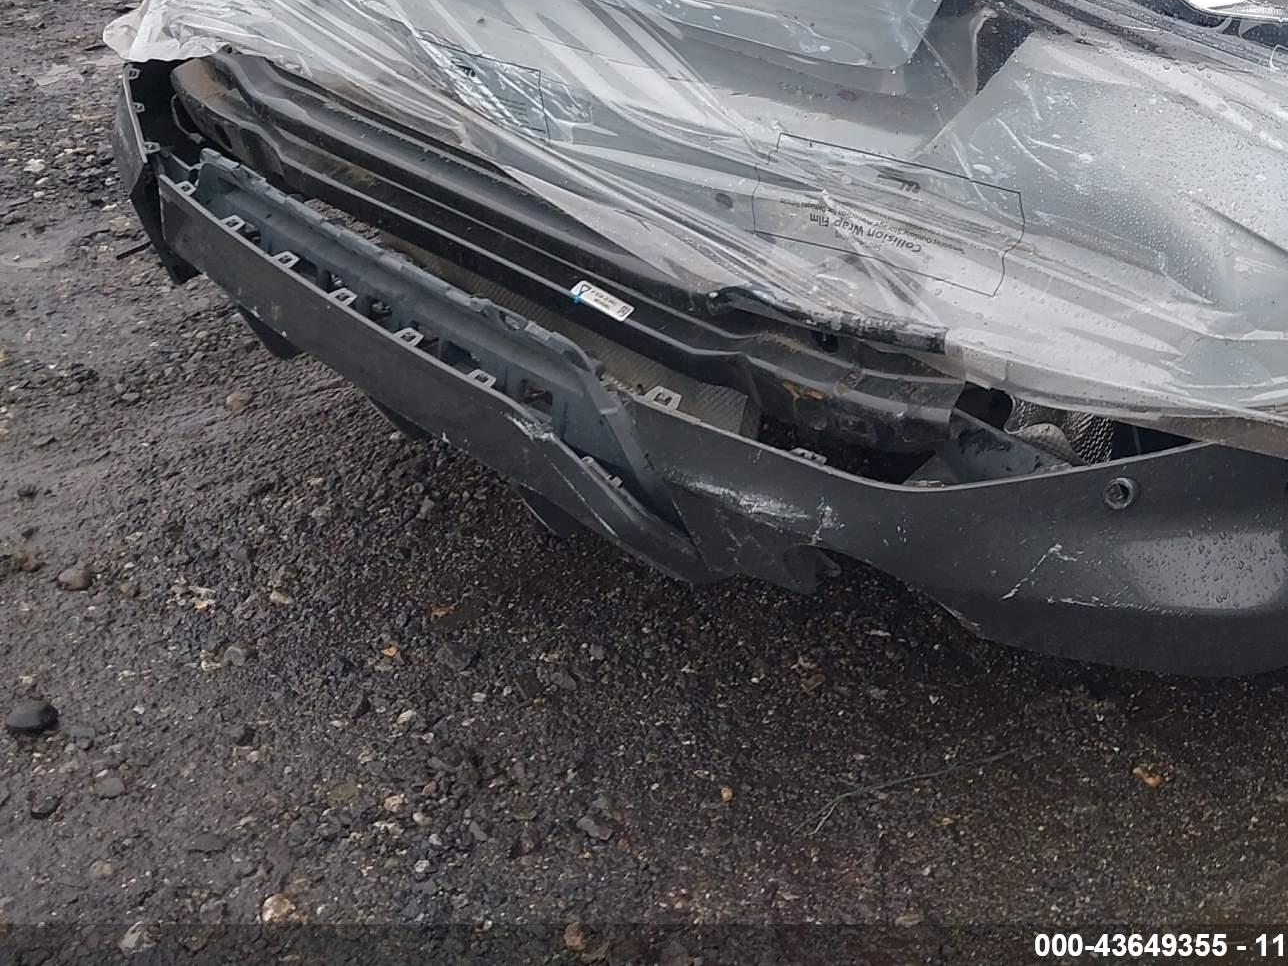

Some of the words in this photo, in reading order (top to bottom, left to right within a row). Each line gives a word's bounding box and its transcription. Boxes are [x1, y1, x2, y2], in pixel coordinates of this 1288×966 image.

[809, 213, 830, 227] Film
[834, 216, 865, 237] Wrap
[867, 228, 922, 254] Collision
